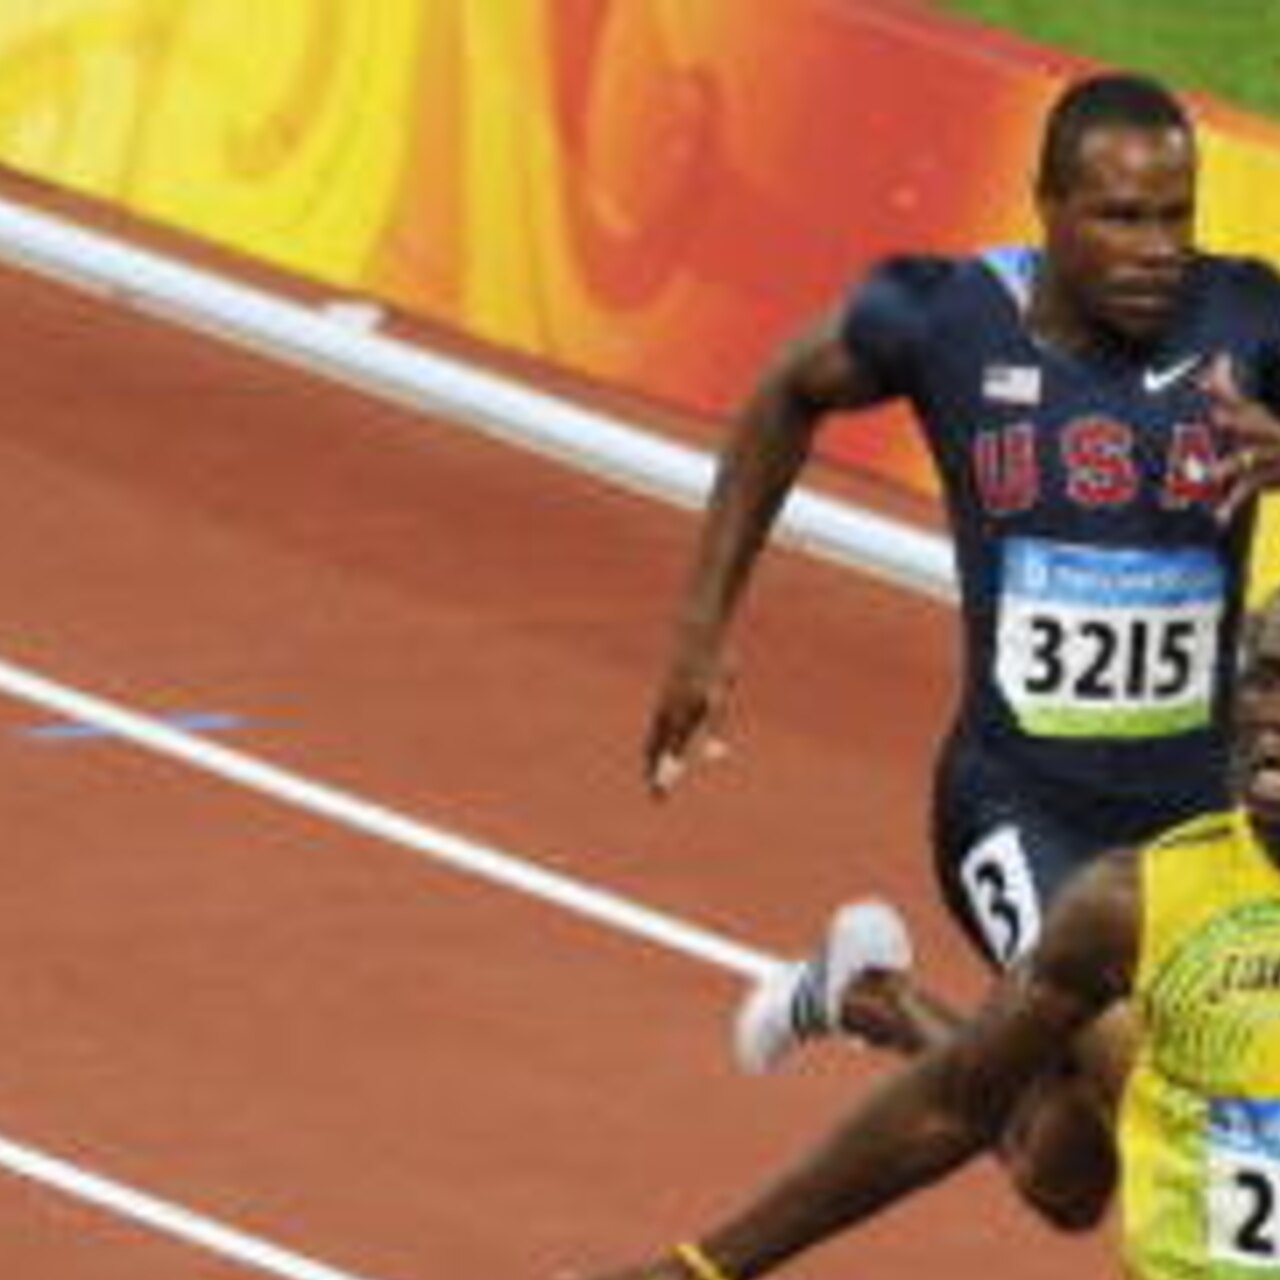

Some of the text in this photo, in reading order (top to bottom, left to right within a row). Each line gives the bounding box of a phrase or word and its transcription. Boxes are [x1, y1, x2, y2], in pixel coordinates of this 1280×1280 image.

[972, 417, 1222, 510] USA
[1024, 615, 1197, 700] 3215
[974, 862, 1021, 961] 3
